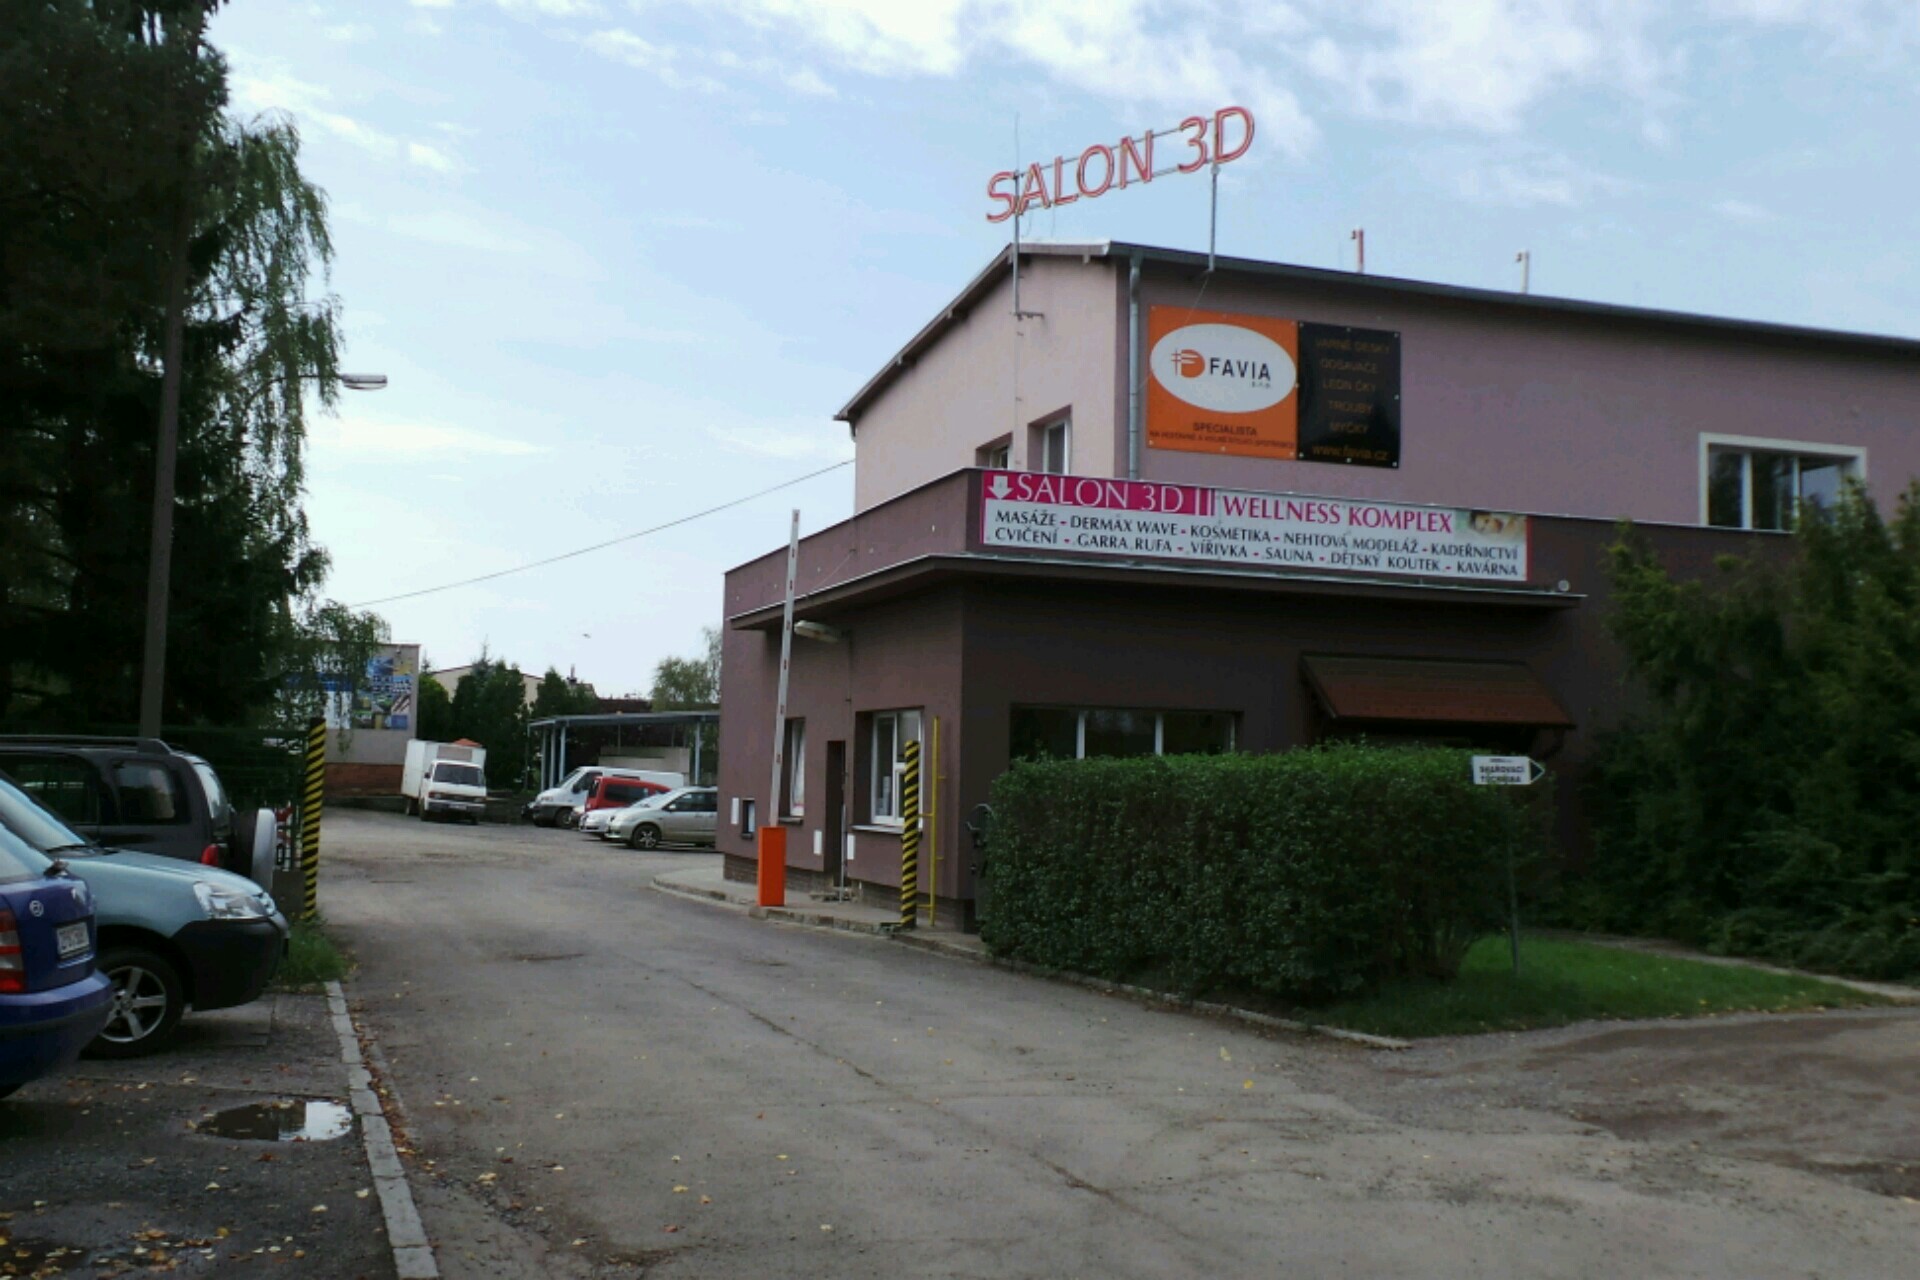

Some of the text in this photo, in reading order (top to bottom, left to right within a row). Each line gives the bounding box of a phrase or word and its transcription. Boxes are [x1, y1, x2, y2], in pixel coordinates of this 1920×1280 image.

[986, 106, 1255, 223] SALON 3D
[1210, 357, 1271, 381] FAVIA
[1193, 422, 1257, 436] SPECIALISTA
[1016, 474, 1184, 513] SALON 3D
[1222, 495, 1453, 534] WELLNESS KOMPLEX
[995, 509, 1518, 560] MASÁŽE DERMAX WAVE KOSMETIKA NEHTOVÁ MODELÁŽ KADEŘNICTVÍ
[995, 527, 1518, 576] CVIČENÍ GARRA RUFA VÍŘIVKA SAUNA DĚTSKÝ KOUTEK KAVÁRNA
